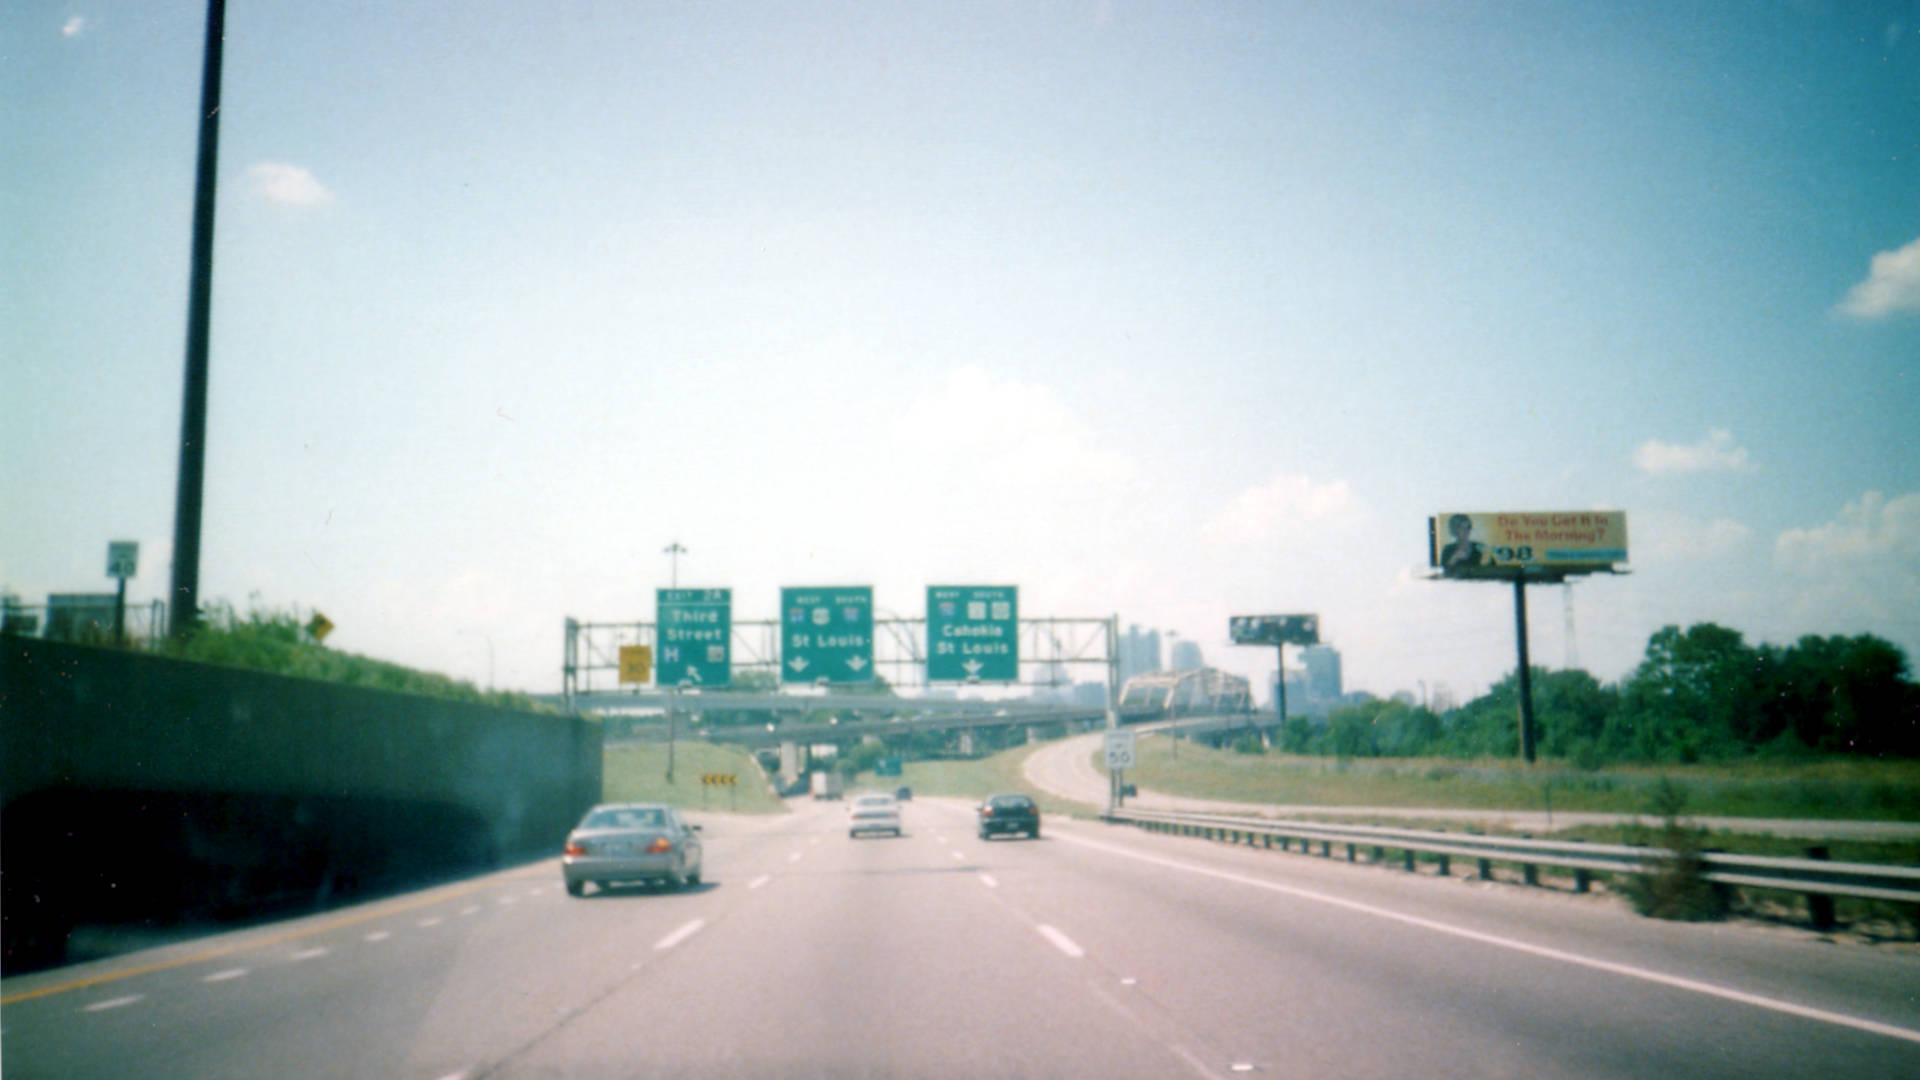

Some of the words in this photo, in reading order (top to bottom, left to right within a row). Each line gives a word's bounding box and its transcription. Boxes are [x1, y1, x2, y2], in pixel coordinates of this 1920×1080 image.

[1523, 516, 1547, 526] You
[1551, 515, 1577, 526] Get
[1505, 530, 1531, 541] The
[1534, 528, 1605, 543] Morning?
[672, 609, 719, 623] Third
[666, 628, 722, 641] Street
[942, 624, 1003, 637] Cahokia
[792, 633, 809, 647] St
[817, 633, 863, 647] Louis
[936, 641, 955, 655] St
[962, 641, 1009, 655] Louis
